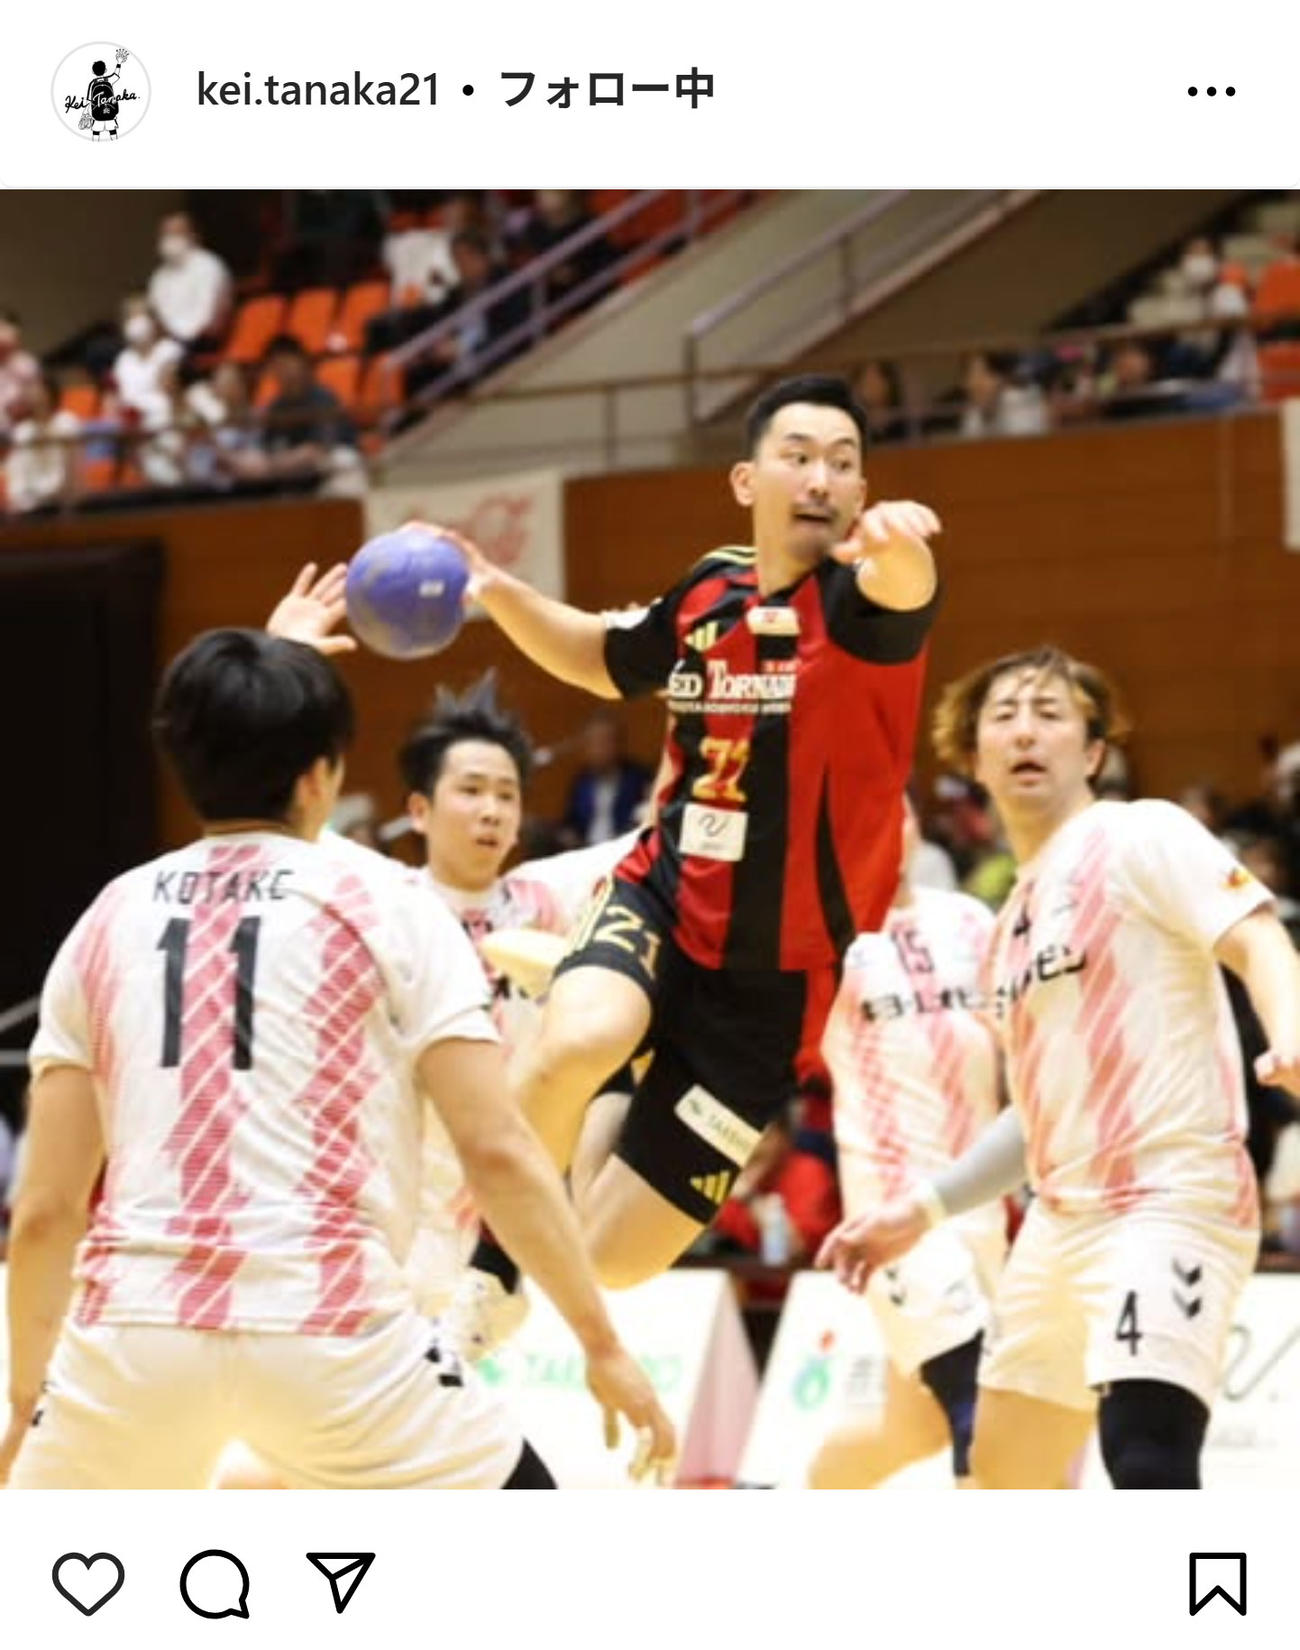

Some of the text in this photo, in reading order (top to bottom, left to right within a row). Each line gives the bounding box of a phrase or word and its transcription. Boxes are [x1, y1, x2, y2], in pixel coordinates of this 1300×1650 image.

[692, 736, 750, 801] 21
[153, 870, 294, 904] KOTAKE
[596, 905, 661, 978] 21
[156, 915, 261, 1069] 11
[1116, 1290, 1143, 1356] 4
